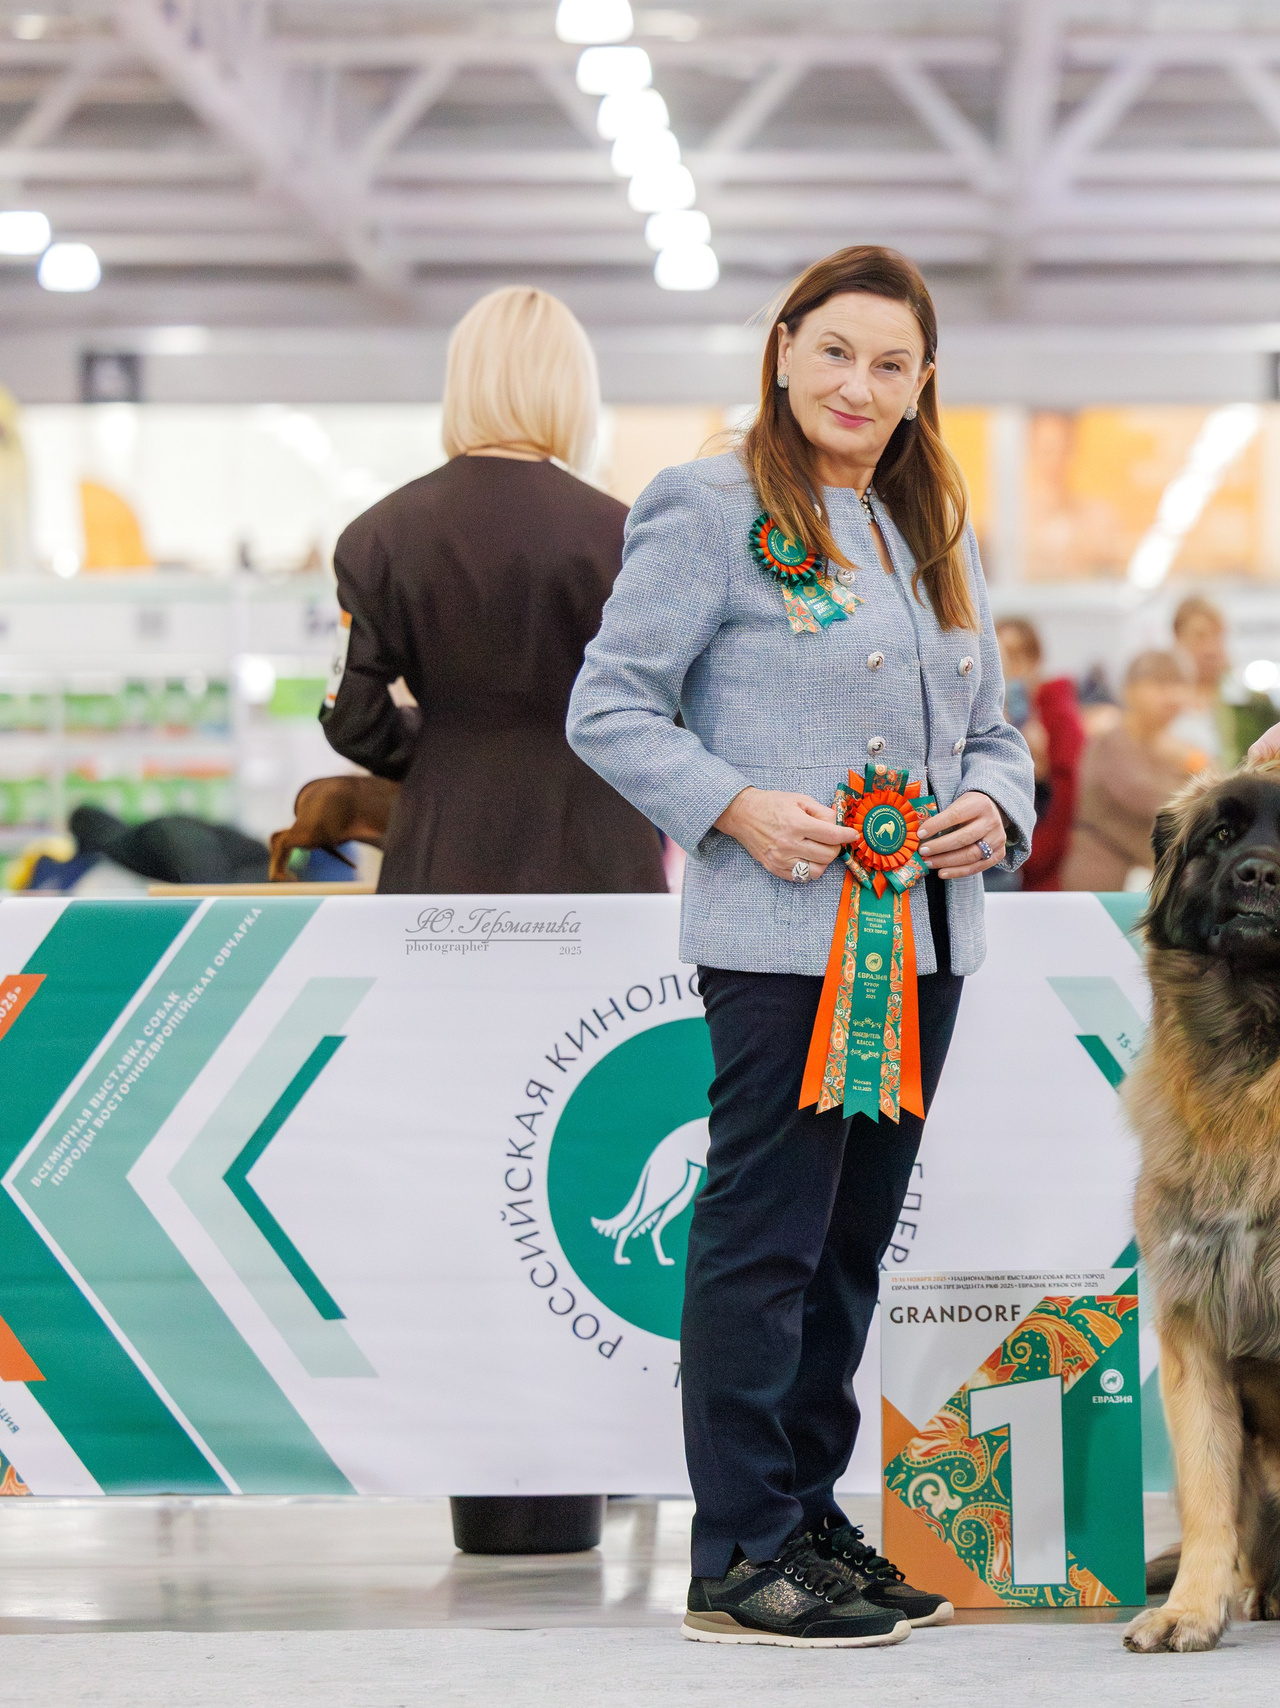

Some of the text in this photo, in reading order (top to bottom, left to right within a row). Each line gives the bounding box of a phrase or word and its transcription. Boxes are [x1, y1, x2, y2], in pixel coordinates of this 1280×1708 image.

[31, 990, 181, 1188] ВСЕМИРНАЯ ВЫСТАВКА СОБАК
[50, 1129, 98, 1187] ПОРОДЫ
[214, 906, 263, 967] ОВЧАРКА
[500, 1077, 623, 1359] РОССИЙСКАЯ
[889, 1304, 1021, 1324] GRANDORF
[969, 1375, 1067, 1585] 1
[1092, 1395, 1133, 1404] ЕВРАЗИЯ
